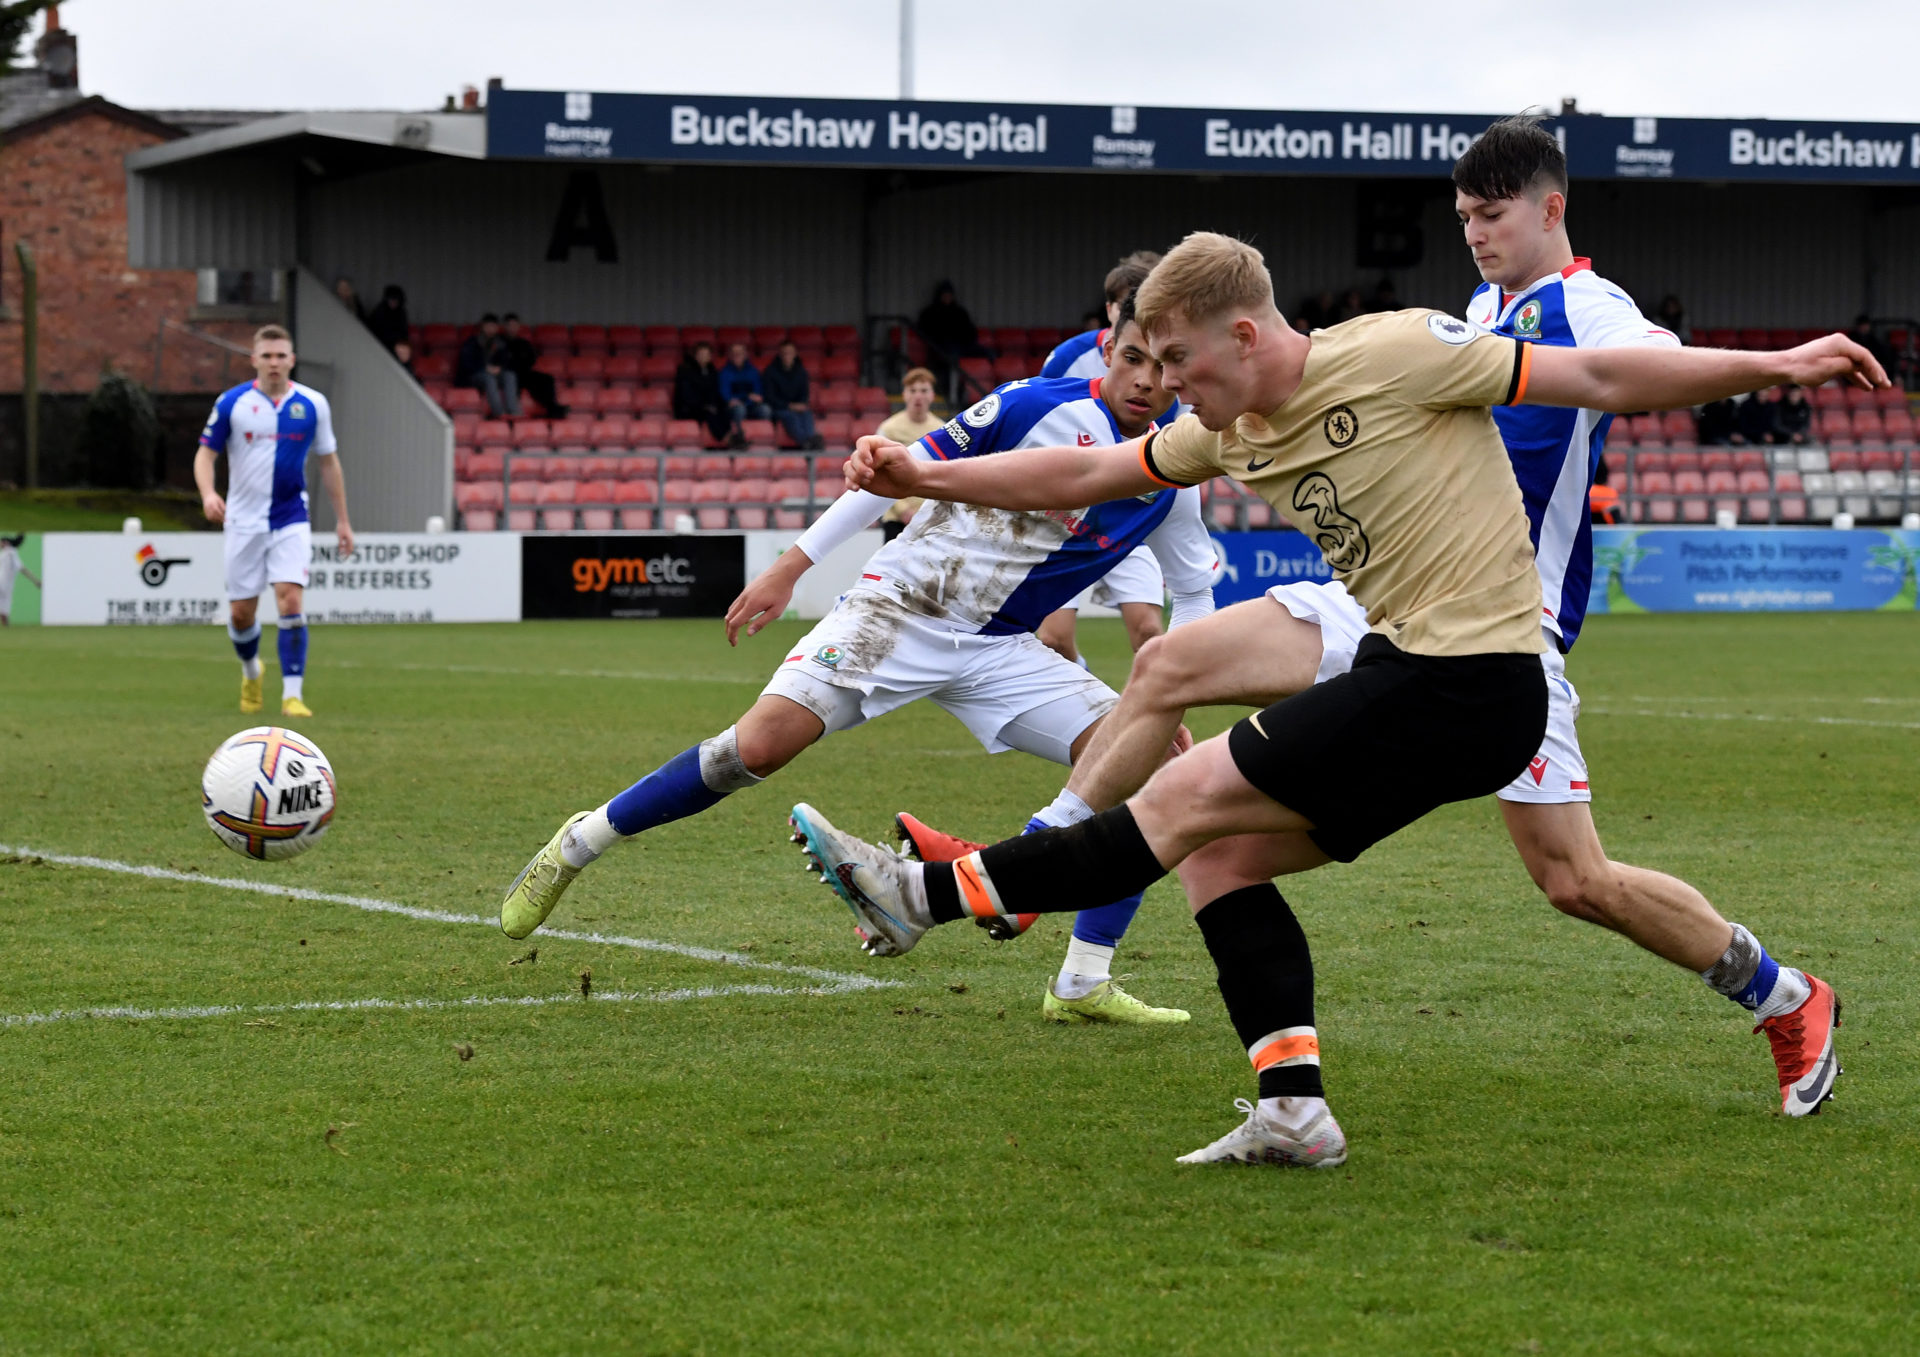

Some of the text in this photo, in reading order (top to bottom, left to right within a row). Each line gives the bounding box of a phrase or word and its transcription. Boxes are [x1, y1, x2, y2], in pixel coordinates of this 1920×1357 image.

[545, 122, 613, 146] Ramsay
[671, 105, 1047, 160] Buckshaw Hospital
[1205, 118, 1334, 159] Euxton
[1342, 121, 1413, 160] Hall
[1093, 134, 1156, 158] Ramsay
[1616, 144, 1674, 168] Ramsay
[1729, 128, 1903, 168] Buckshaw
[547, 168, 619, 262] A
[351, 544, 401, 564] STOP
[407, 544, 460, 564] SHOP
[1255, 549, 1330, 577] David
[1680, 541, 1847, 562] Products to Improve
[333, 569, 432, 590] REFEREES
[1687, 565, 1728, 583] Pitch
[1733, 564, 1842, 583] Performance
[106, 599, 219, 618] THE REF STOP
[305, 607, 433, 625] ww.therefstop.co.uk
[278, 780, 322, 814] NIKE
